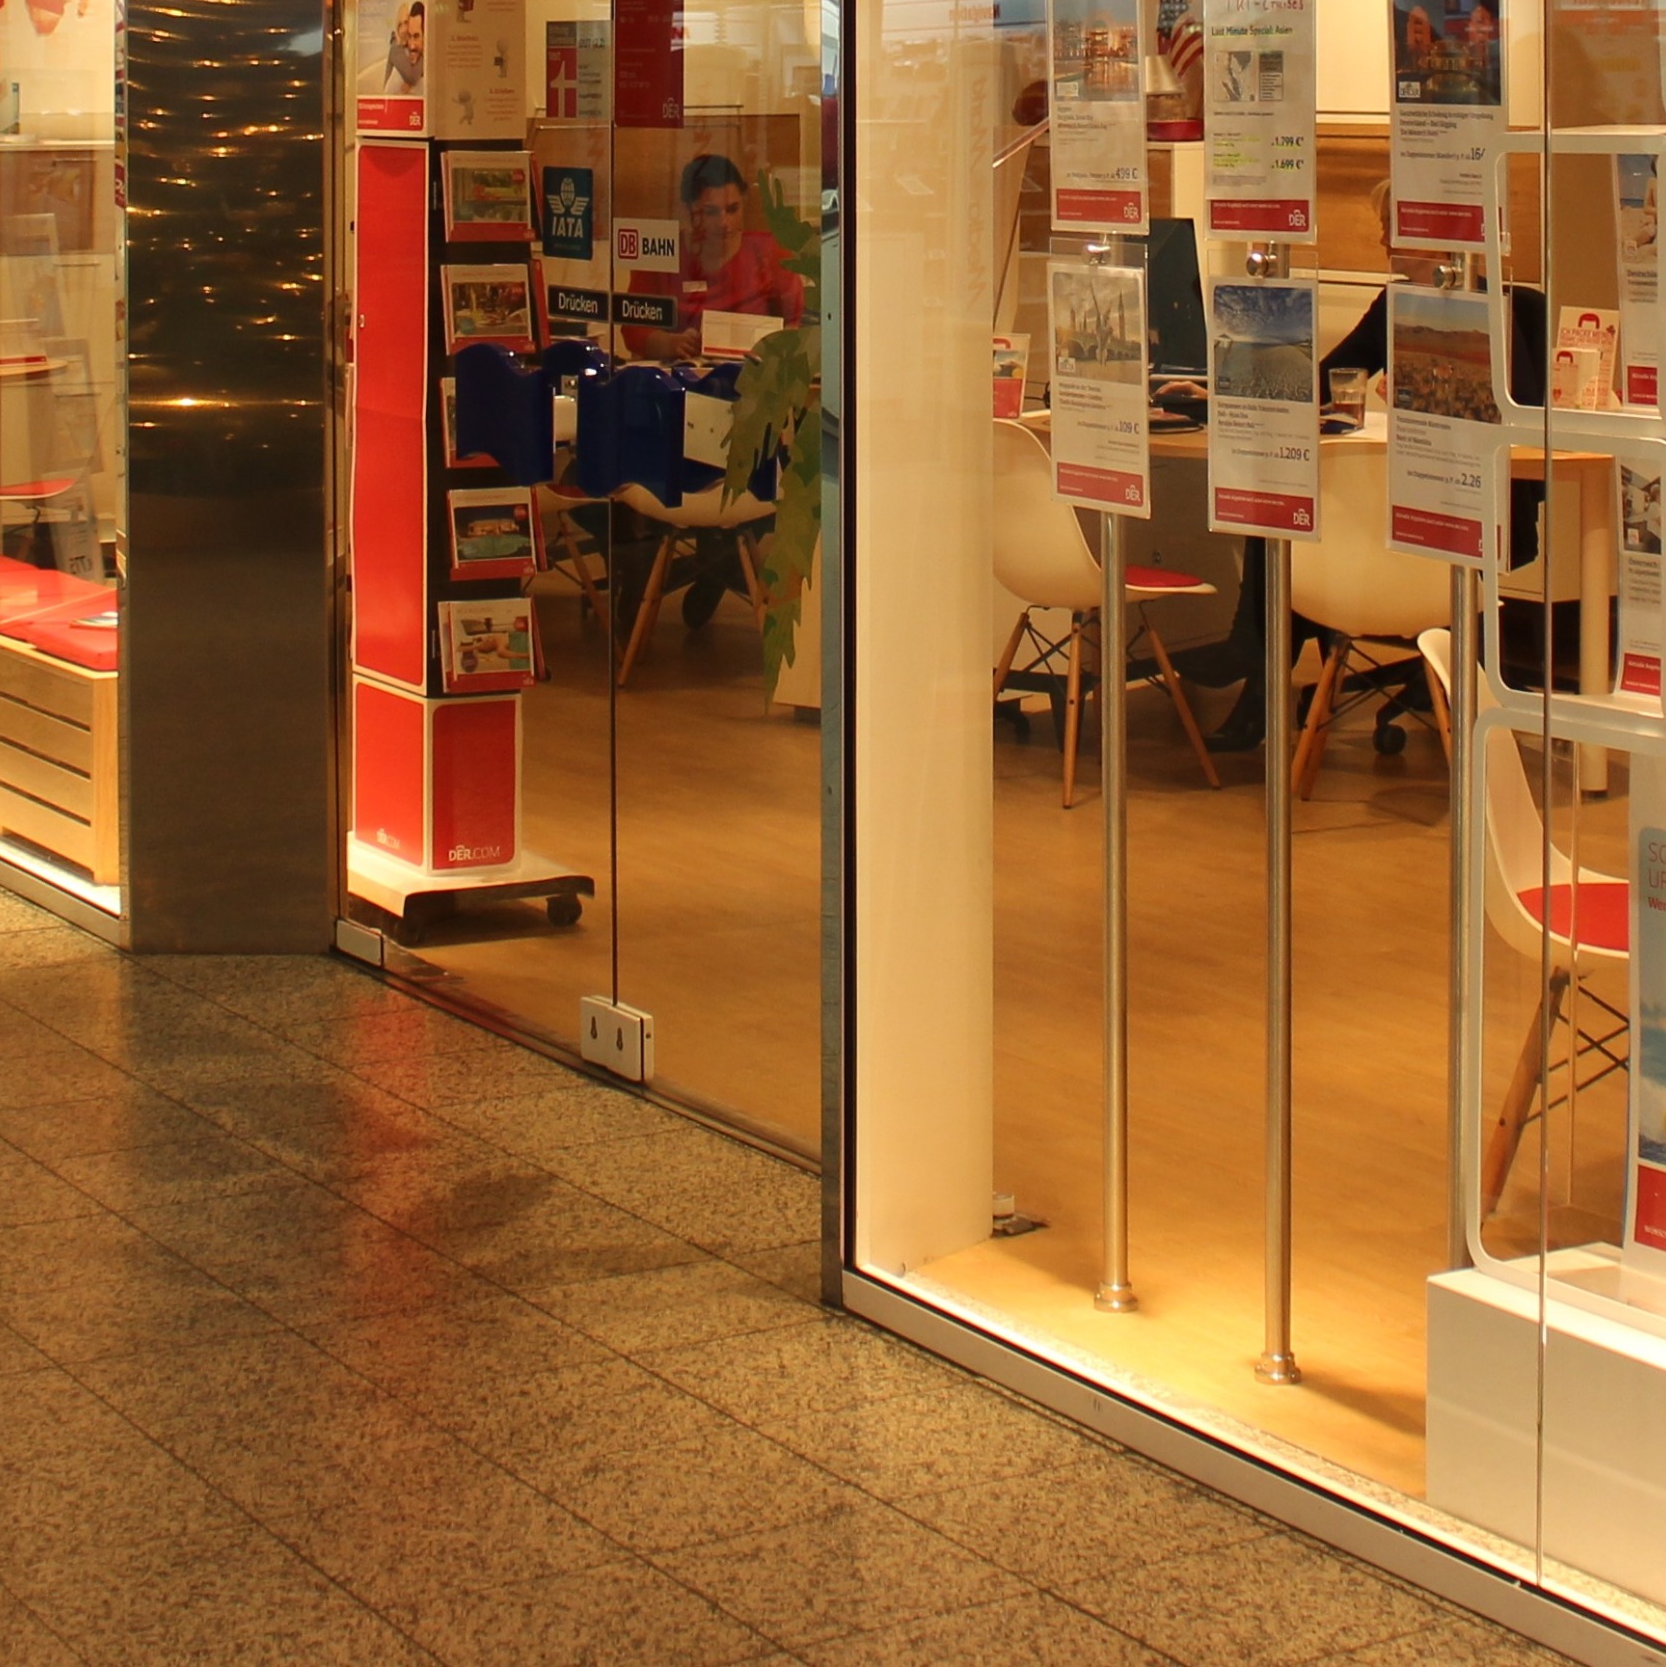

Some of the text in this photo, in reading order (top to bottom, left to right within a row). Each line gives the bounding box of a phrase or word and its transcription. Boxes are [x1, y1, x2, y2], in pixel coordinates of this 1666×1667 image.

[662, 102, 680, 119] DER
[552, 218, 583, 238] IATA
[1289, 214, 1306, 226] DER
[620, 233, 675, 256] DB BAHN
[558, 292, 598, 314] Drücken
[622, 300, 663, 321] Drücken
[1125, 488, 1141, 502] DER
[1293, 512, 1310, 526] DER
[448, 845, 500, 861] DER.COM
